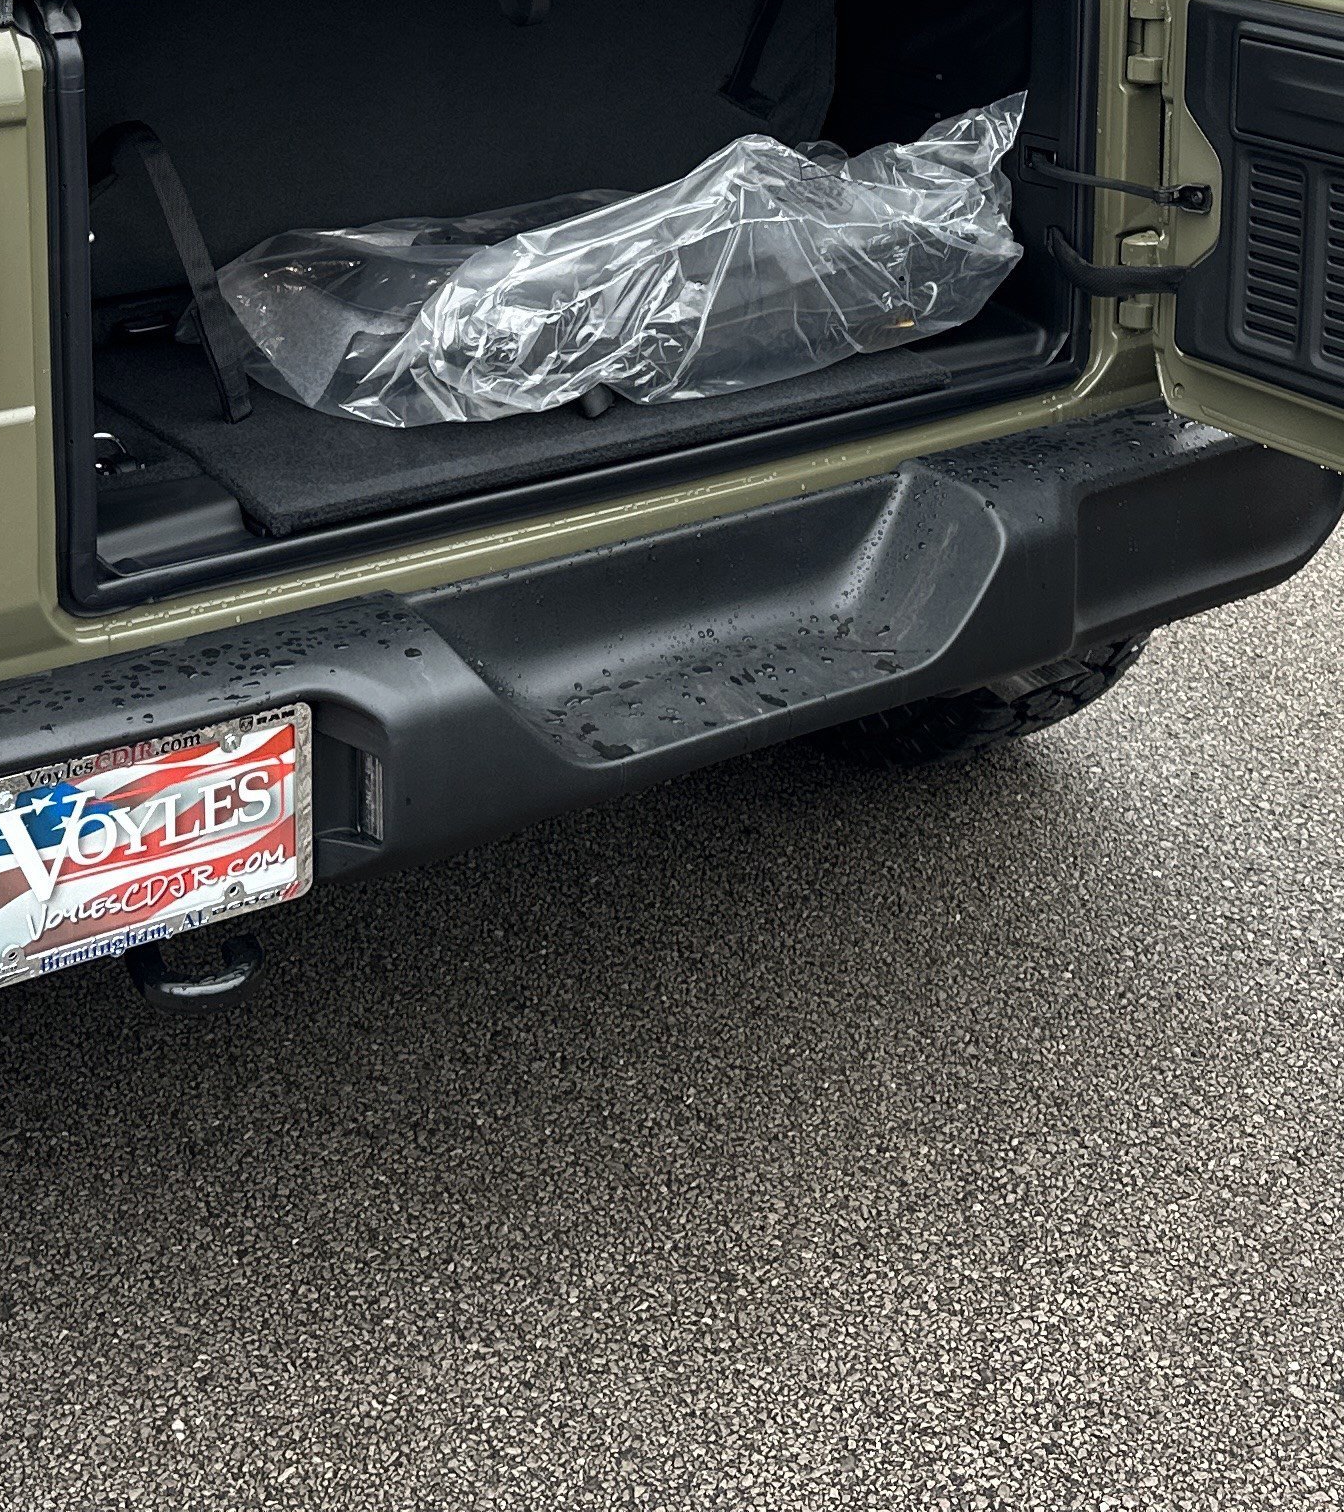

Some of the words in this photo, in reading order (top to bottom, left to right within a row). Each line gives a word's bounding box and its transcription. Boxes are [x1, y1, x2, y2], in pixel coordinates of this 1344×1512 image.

[256, 709, 296, 726] RAM
[25, 732, 201, 789] VoylesCDJR.com
[179, 909, 210, 932] AL
